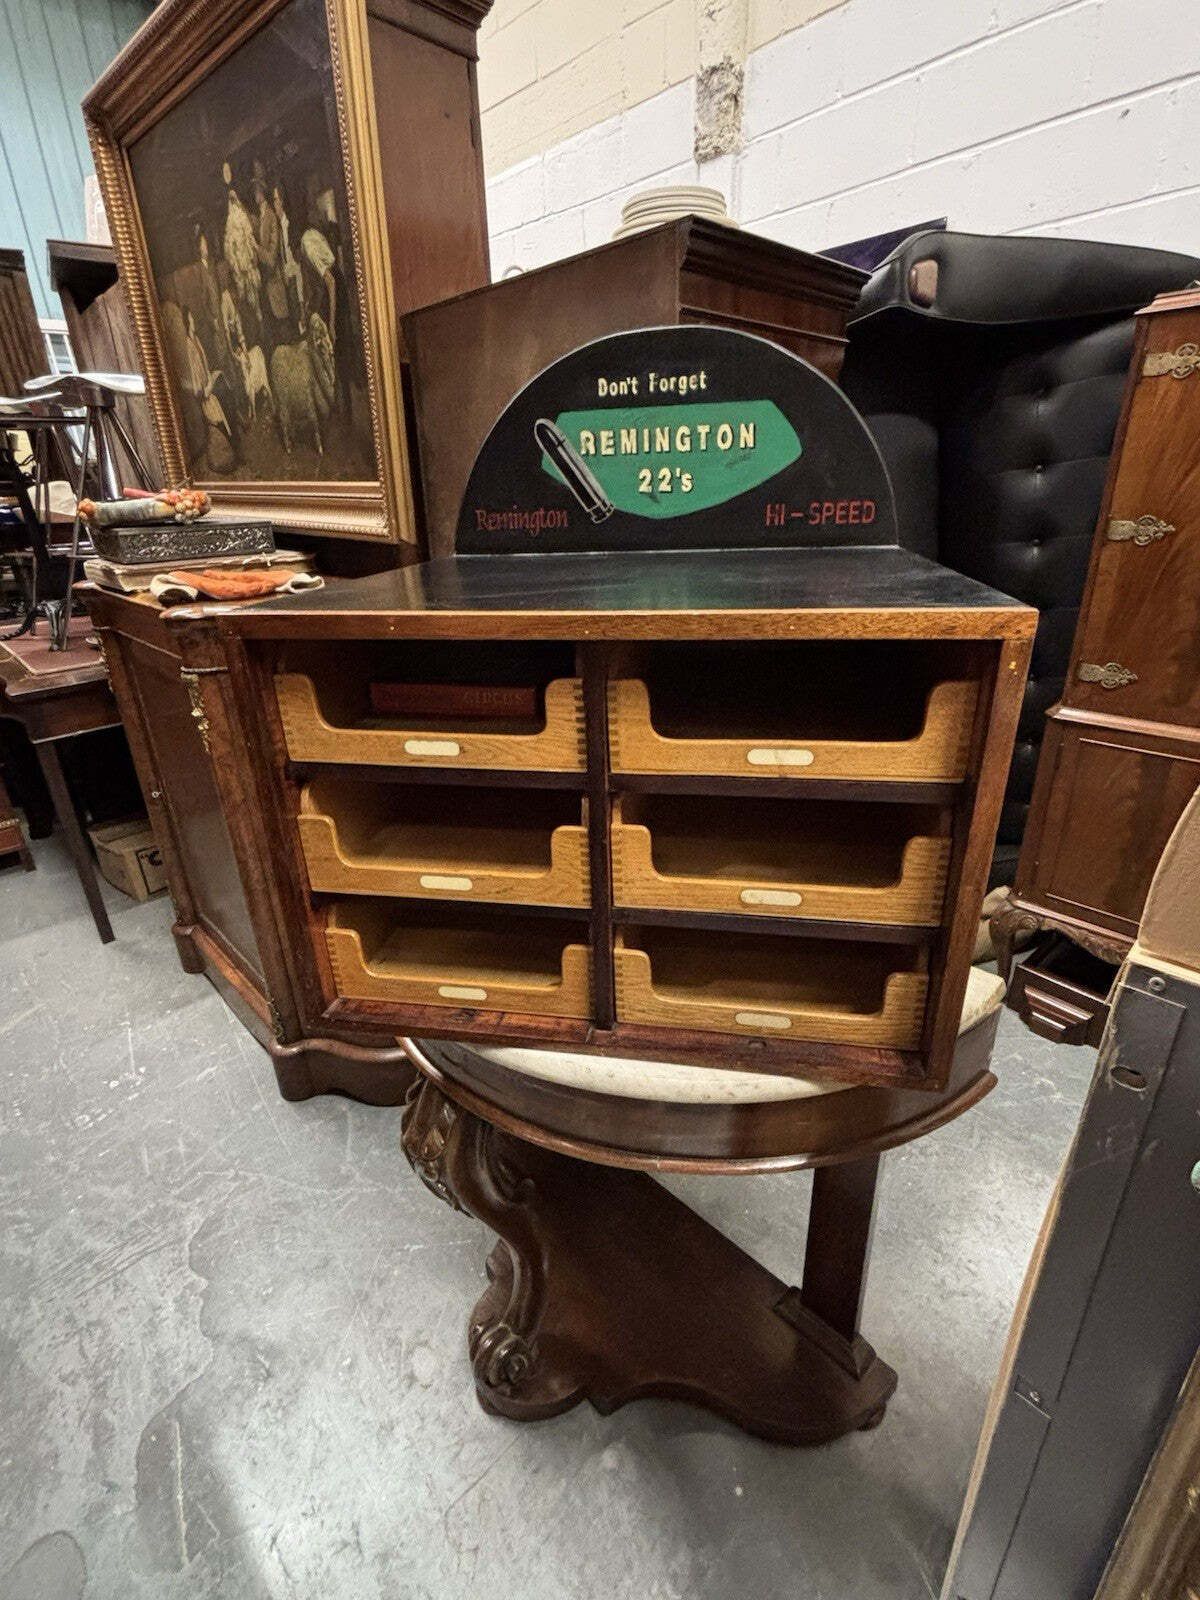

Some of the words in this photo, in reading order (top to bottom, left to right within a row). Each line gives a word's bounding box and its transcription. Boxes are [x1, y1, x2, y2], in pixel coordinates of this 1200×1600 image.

[598, 377, 639, 397] Don't
[648, 370, 707, 395] Forget
[579, 421, 756, 456] REMINGTON
[638, 466, 694, 493] 22's
[475, 505, 569, 538] Remington
